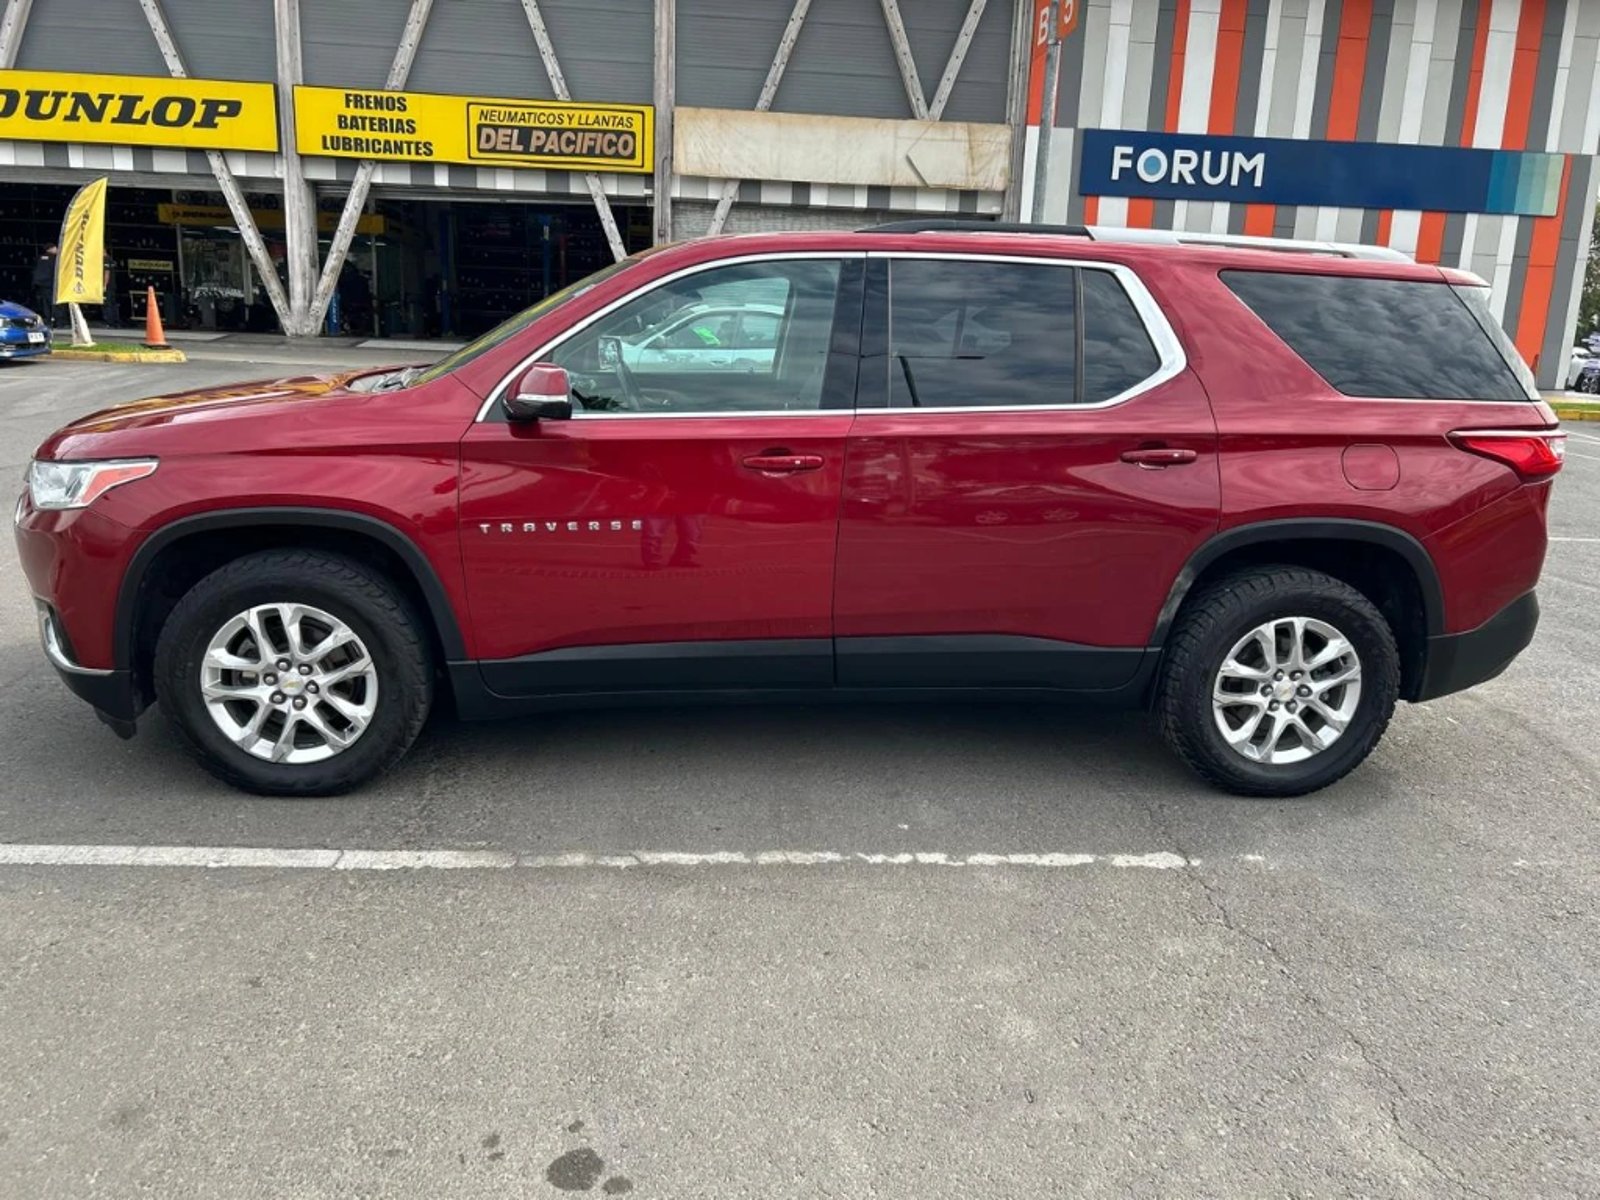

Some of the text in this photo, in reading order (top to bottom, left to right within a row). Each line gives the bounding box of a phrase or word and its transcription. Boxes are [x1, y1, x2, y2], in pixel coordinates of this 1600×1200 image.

[344, 93, 407, 112] FRENOS
[337, 114, 416, 134] BATERIAS
[479, 109, 634, 129] NEUMATICOS Y LLANTAS
[321, 135, 434, 157] LUBRICANTES
[479, 127, 634, 157] DEL PACIFICO
[1111, 146, 1265, 187] FORUM
[479, 520, 642, 534] TRAVERSE
